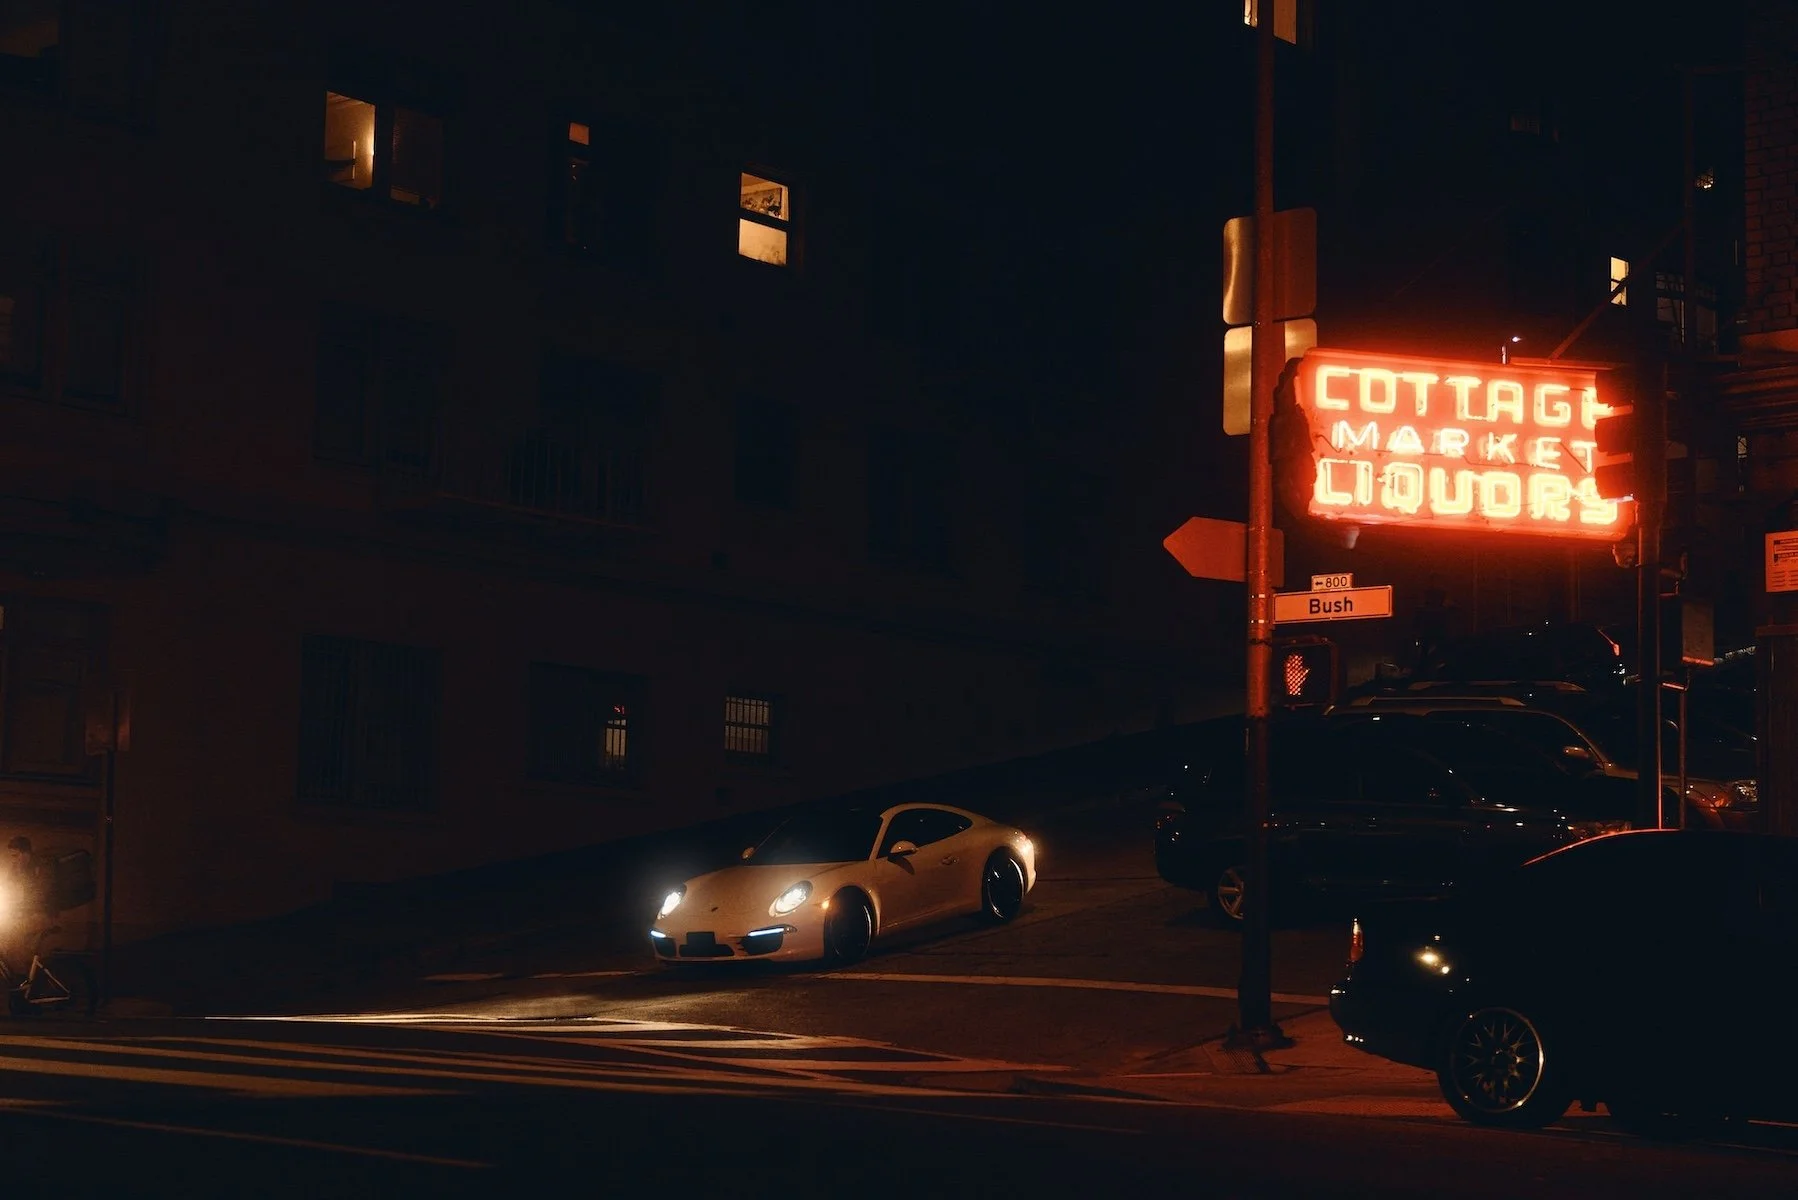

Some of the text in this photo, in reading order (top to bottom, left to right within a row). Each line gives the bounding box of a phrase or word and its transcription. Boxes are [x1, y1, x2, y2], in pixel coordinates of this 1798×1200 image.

[1332, 420, 1597, 473] MARKET
[1314, 457, 1618, 524] LIQUORS
[1325, 577, 1347, 588] 800
[1309, 597, 1353, 614] Bush
